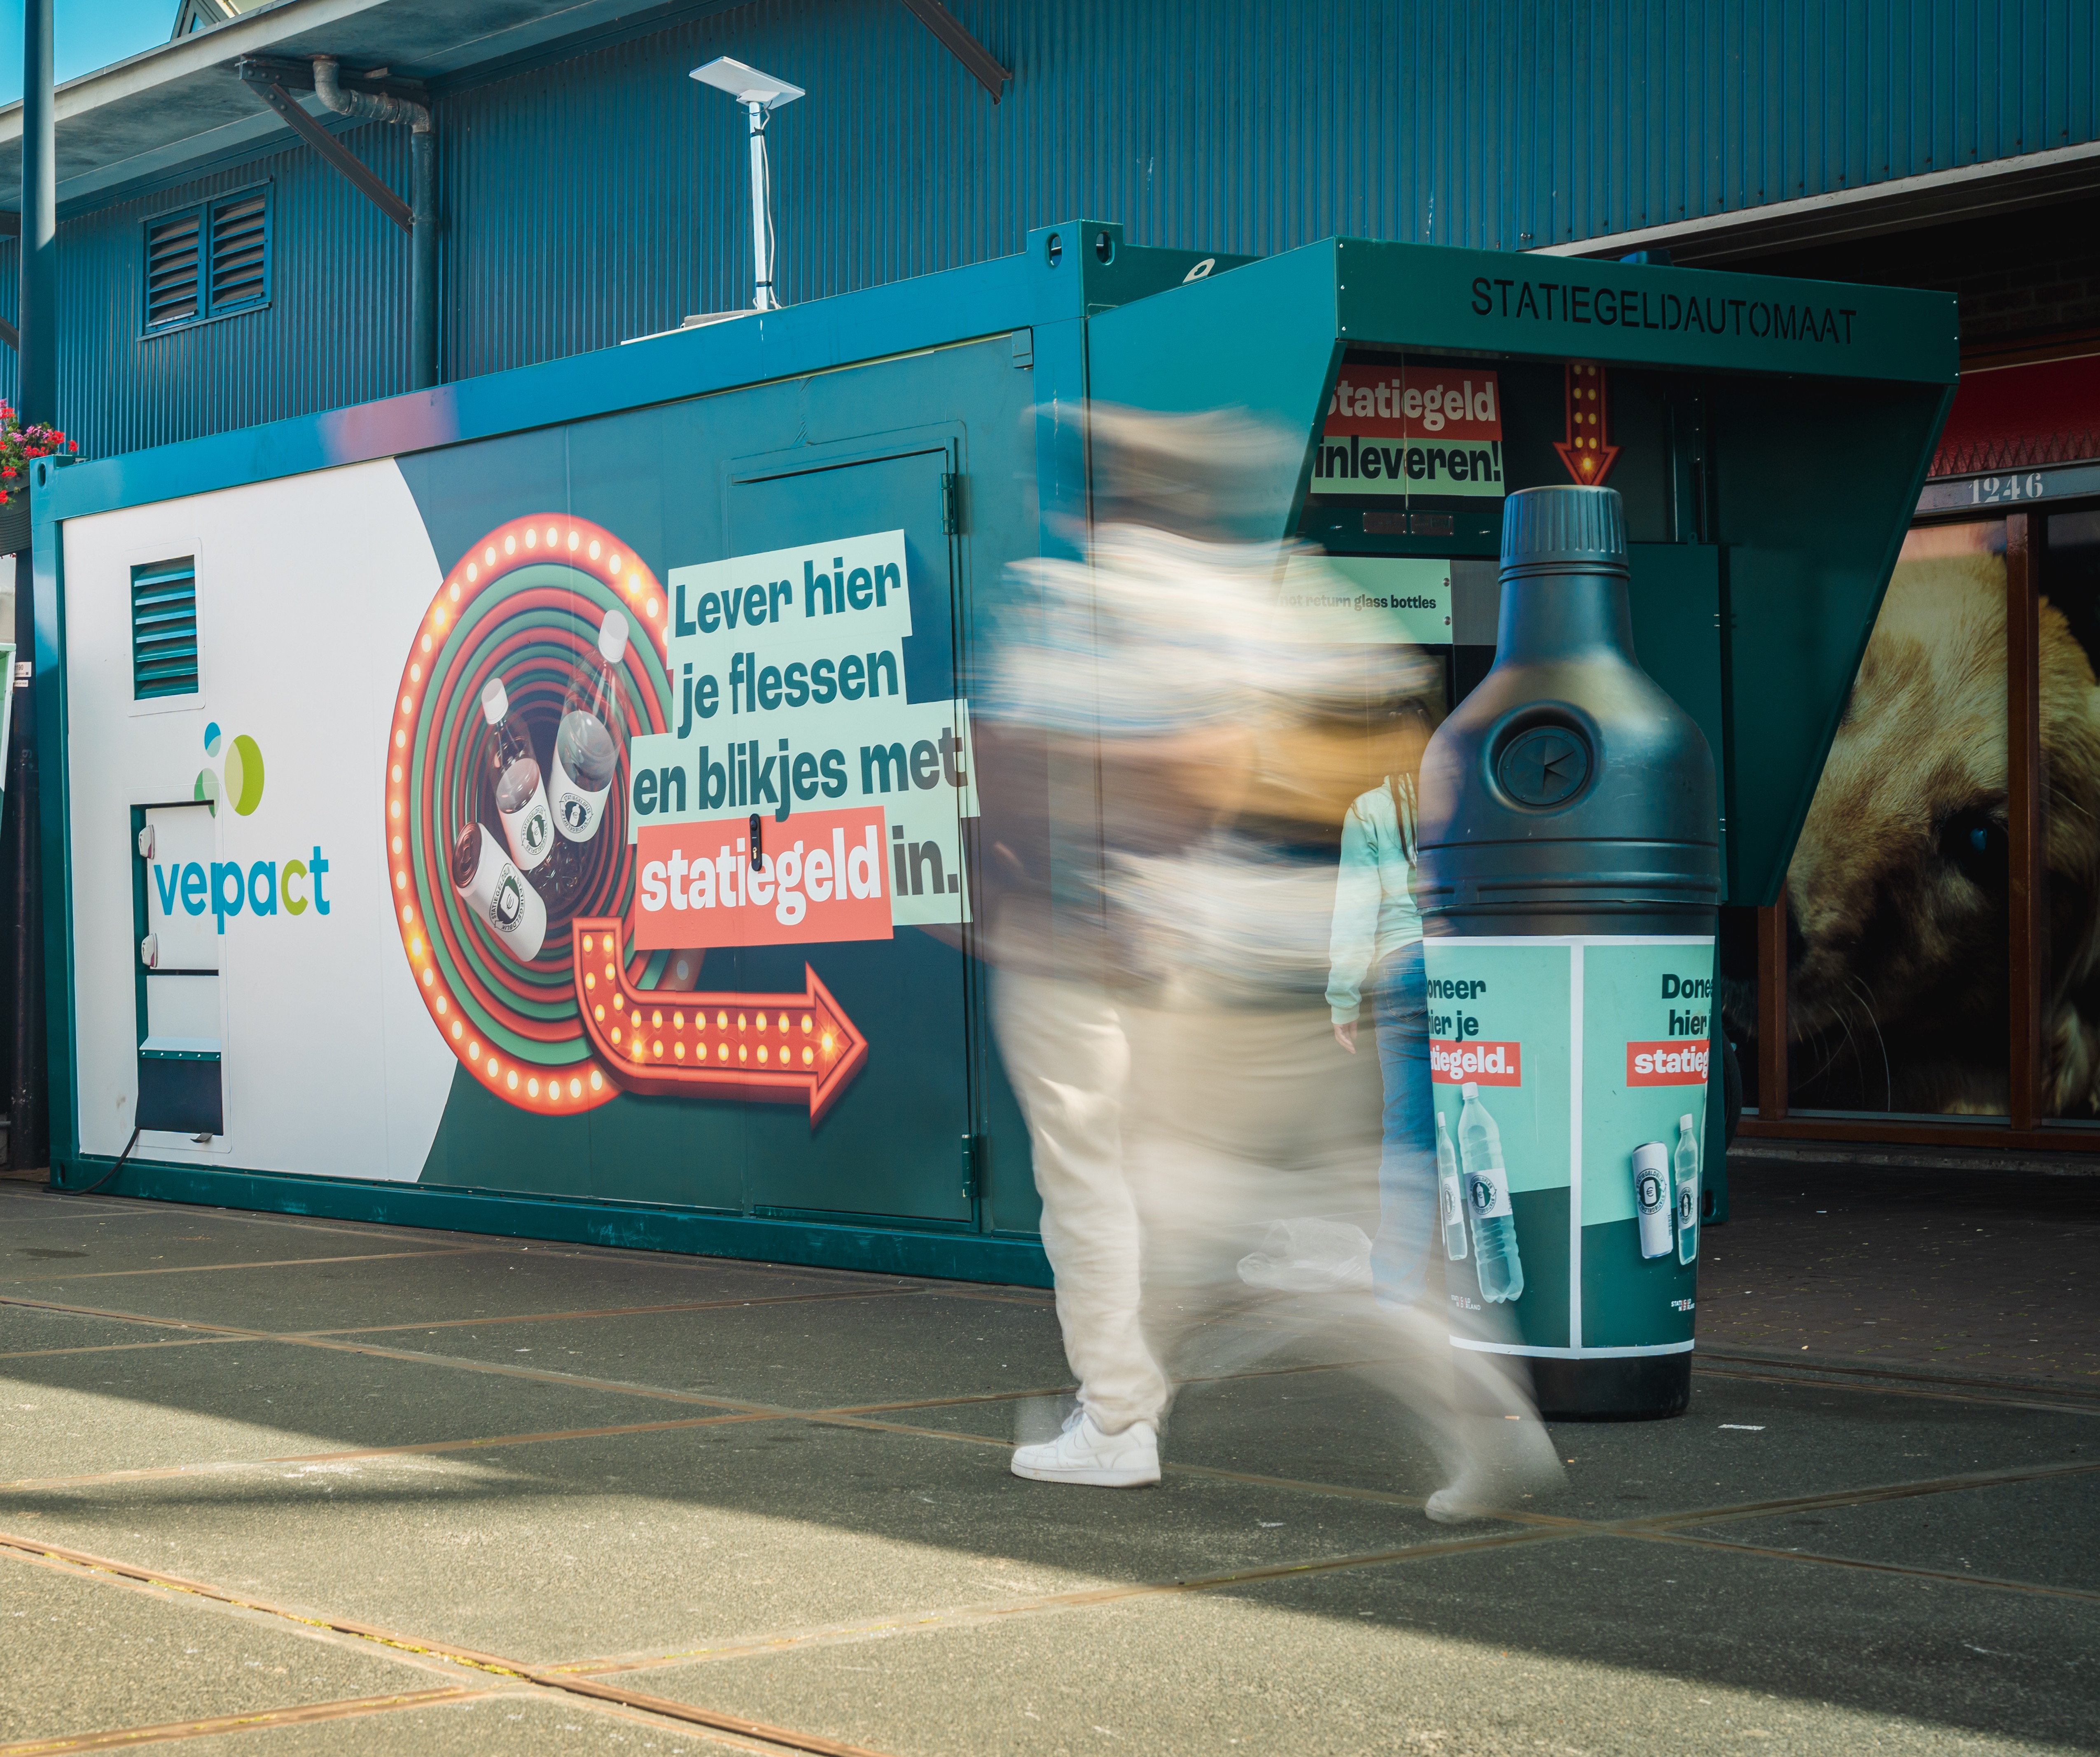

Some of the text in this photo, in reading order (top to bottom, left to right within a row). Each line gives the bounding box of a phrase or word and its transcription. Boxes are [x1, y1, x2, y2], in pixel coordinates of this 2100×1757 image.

[1471, 277, 1857, 344] STATIEGELDAUTOMAAT
[1315, 435, 1502, 482] inleveren!
[1969, 473, 2044, 504] 1246
[675, 557, 901, 637] Lever hier
[1306, 594, 1351, 607] return
[1354, 594, 1388, 611] glass
[1391, 594, 1437, 609] bottles
[678, 650, 899, 739] je flessen
[633, 727, 967, 823] en blikjes met
[154, 846, 330, 934] vepact
[642, 825, 959, 926] statiegeld in.
[1427, 980, 1486, 999] oneer
[1455, 1010, 1479, 1043] je
[1669, 1009, 1707, 1036] hier
